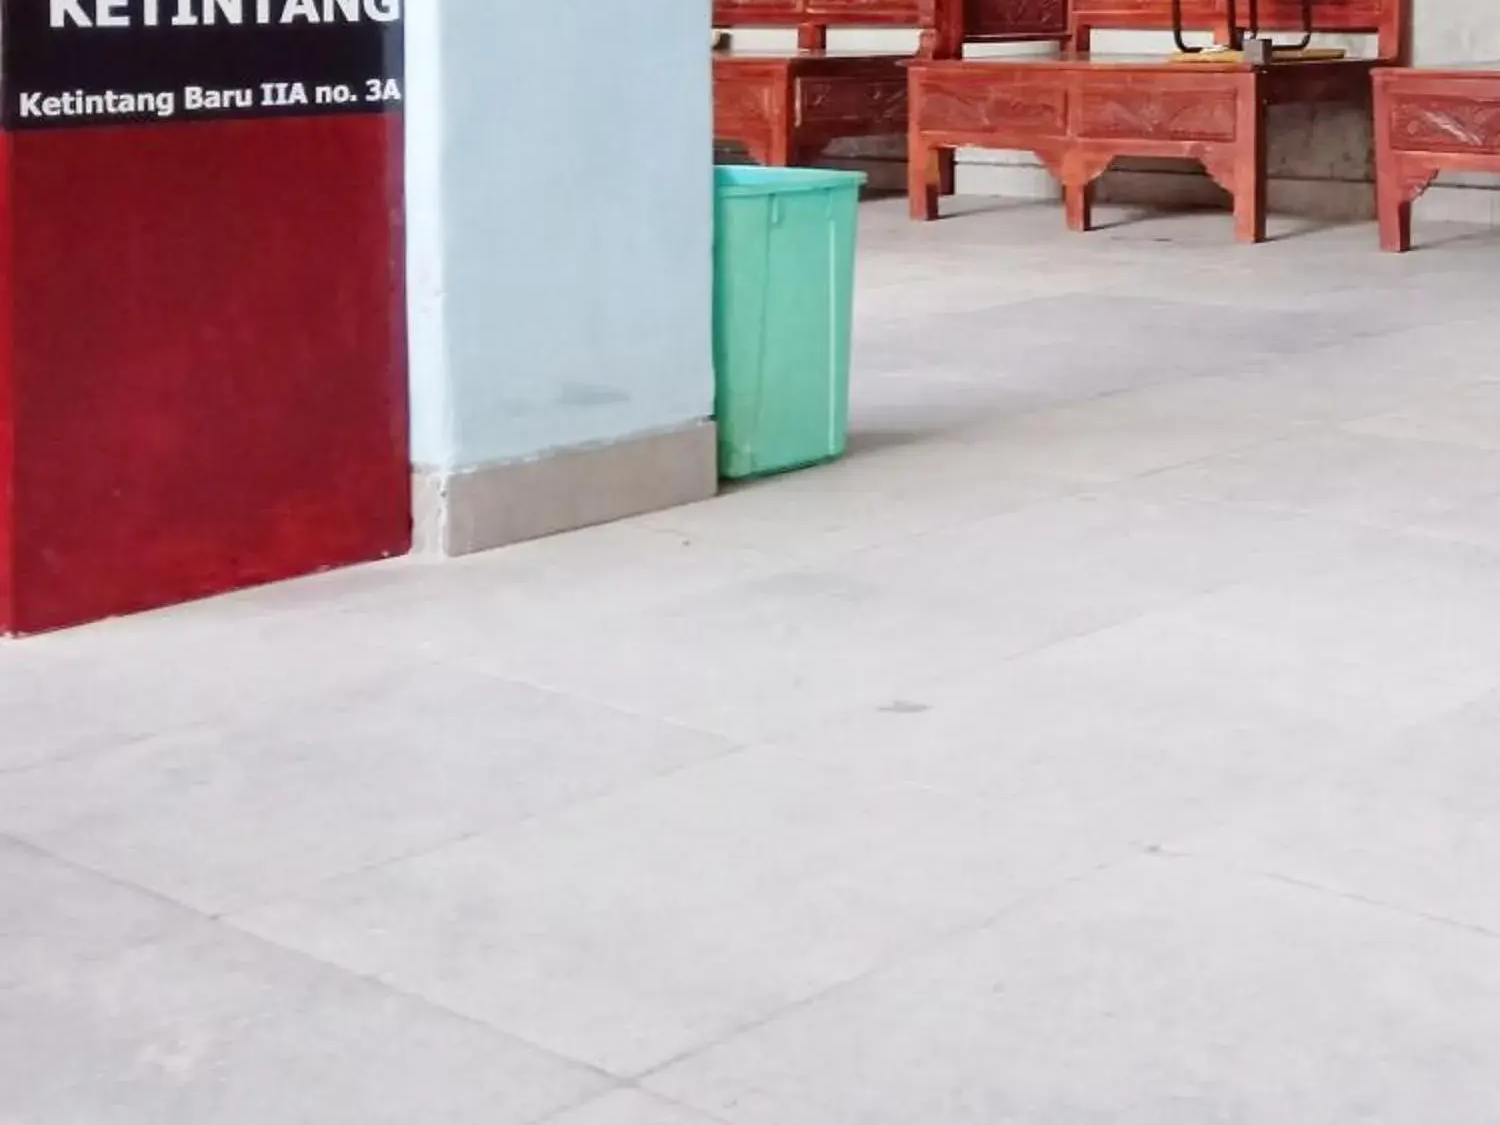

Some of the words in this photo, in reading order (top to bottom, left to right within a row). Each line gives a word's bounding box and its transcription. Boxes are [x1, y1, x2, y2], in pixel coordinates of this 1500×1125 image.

[19, 90, 174, 118] Ketintang
[184, 86, 254, 111] Baru
[260, 82, 309, 106] IIA
[315, 82, 358, 104] no.
[364, 78, 402, 102] 3A
